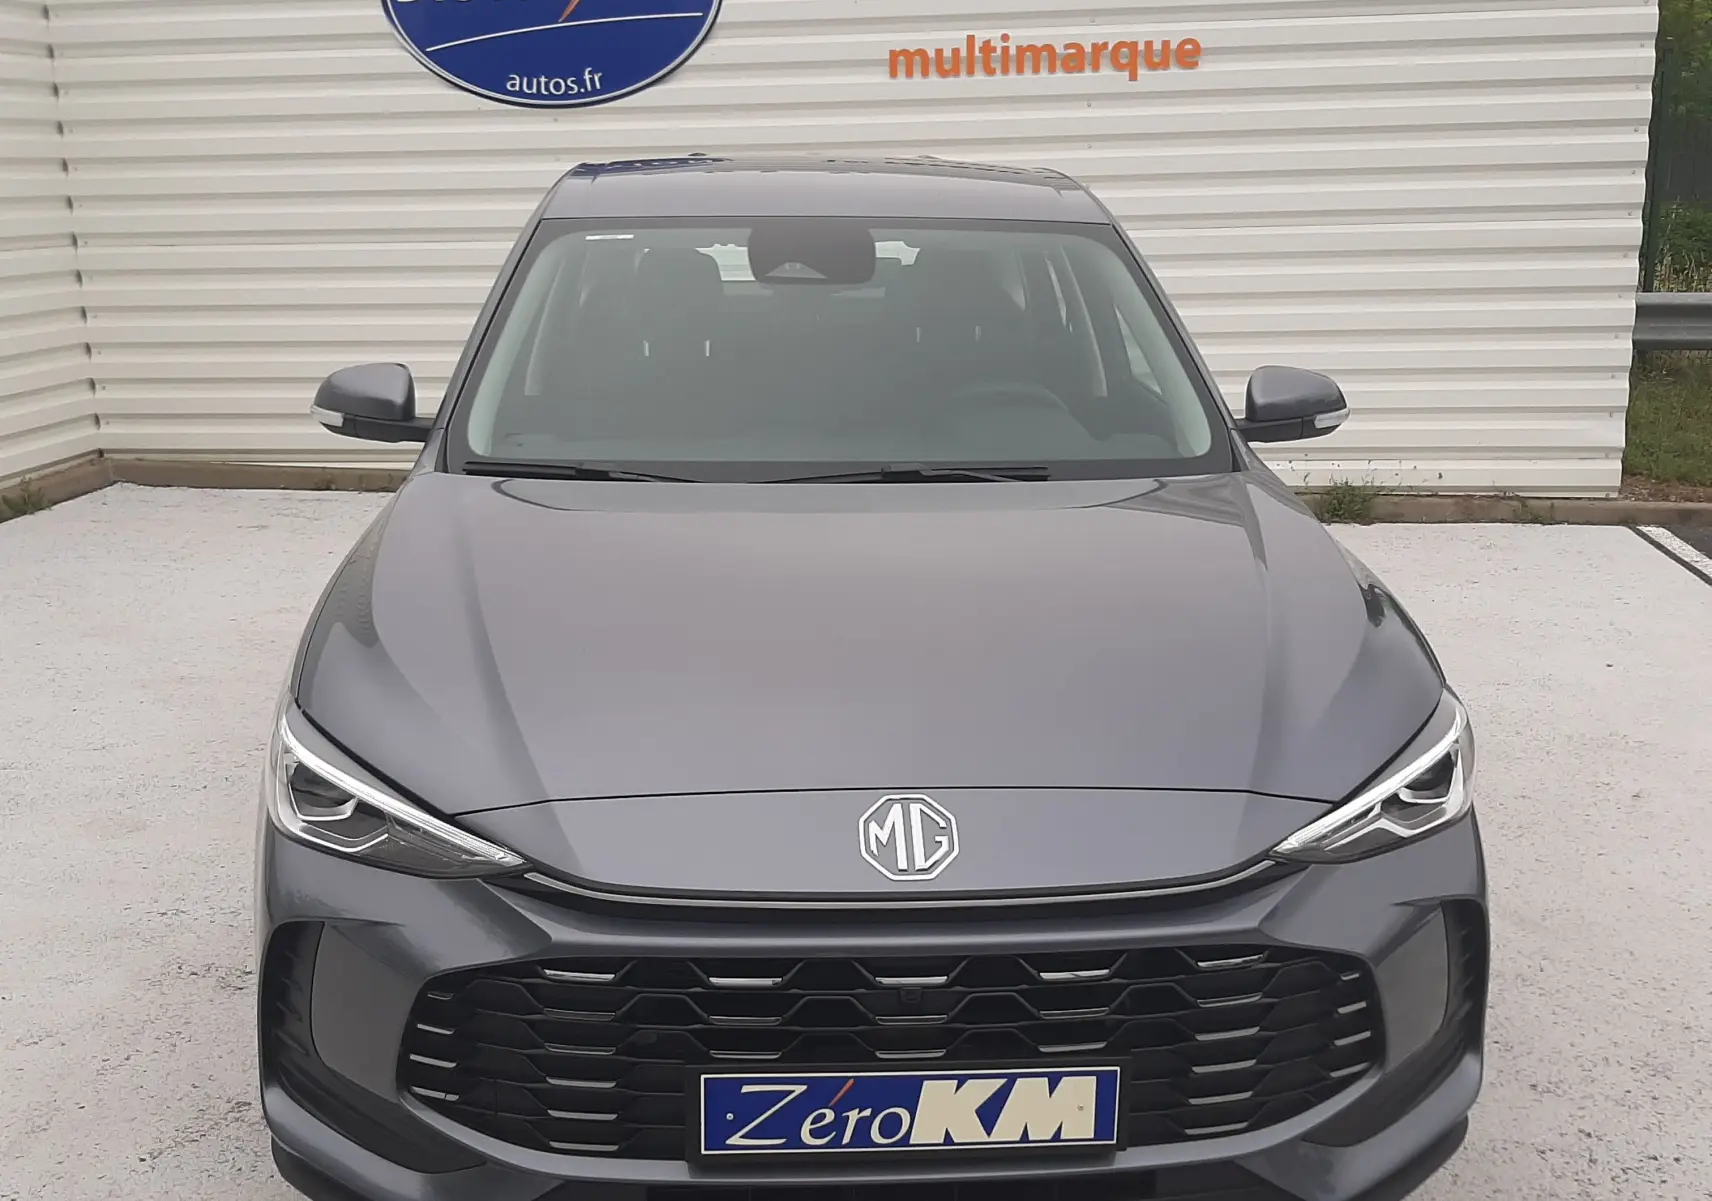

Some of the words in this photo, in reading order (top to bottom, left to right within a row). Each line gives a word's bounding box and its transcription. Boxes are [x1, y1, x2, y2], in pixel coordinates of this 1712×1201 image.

[889, 33, 1202, 81] multimarque
[506, 68, 603, 95] autos.fr
[868, 802, 950, 871] MG
